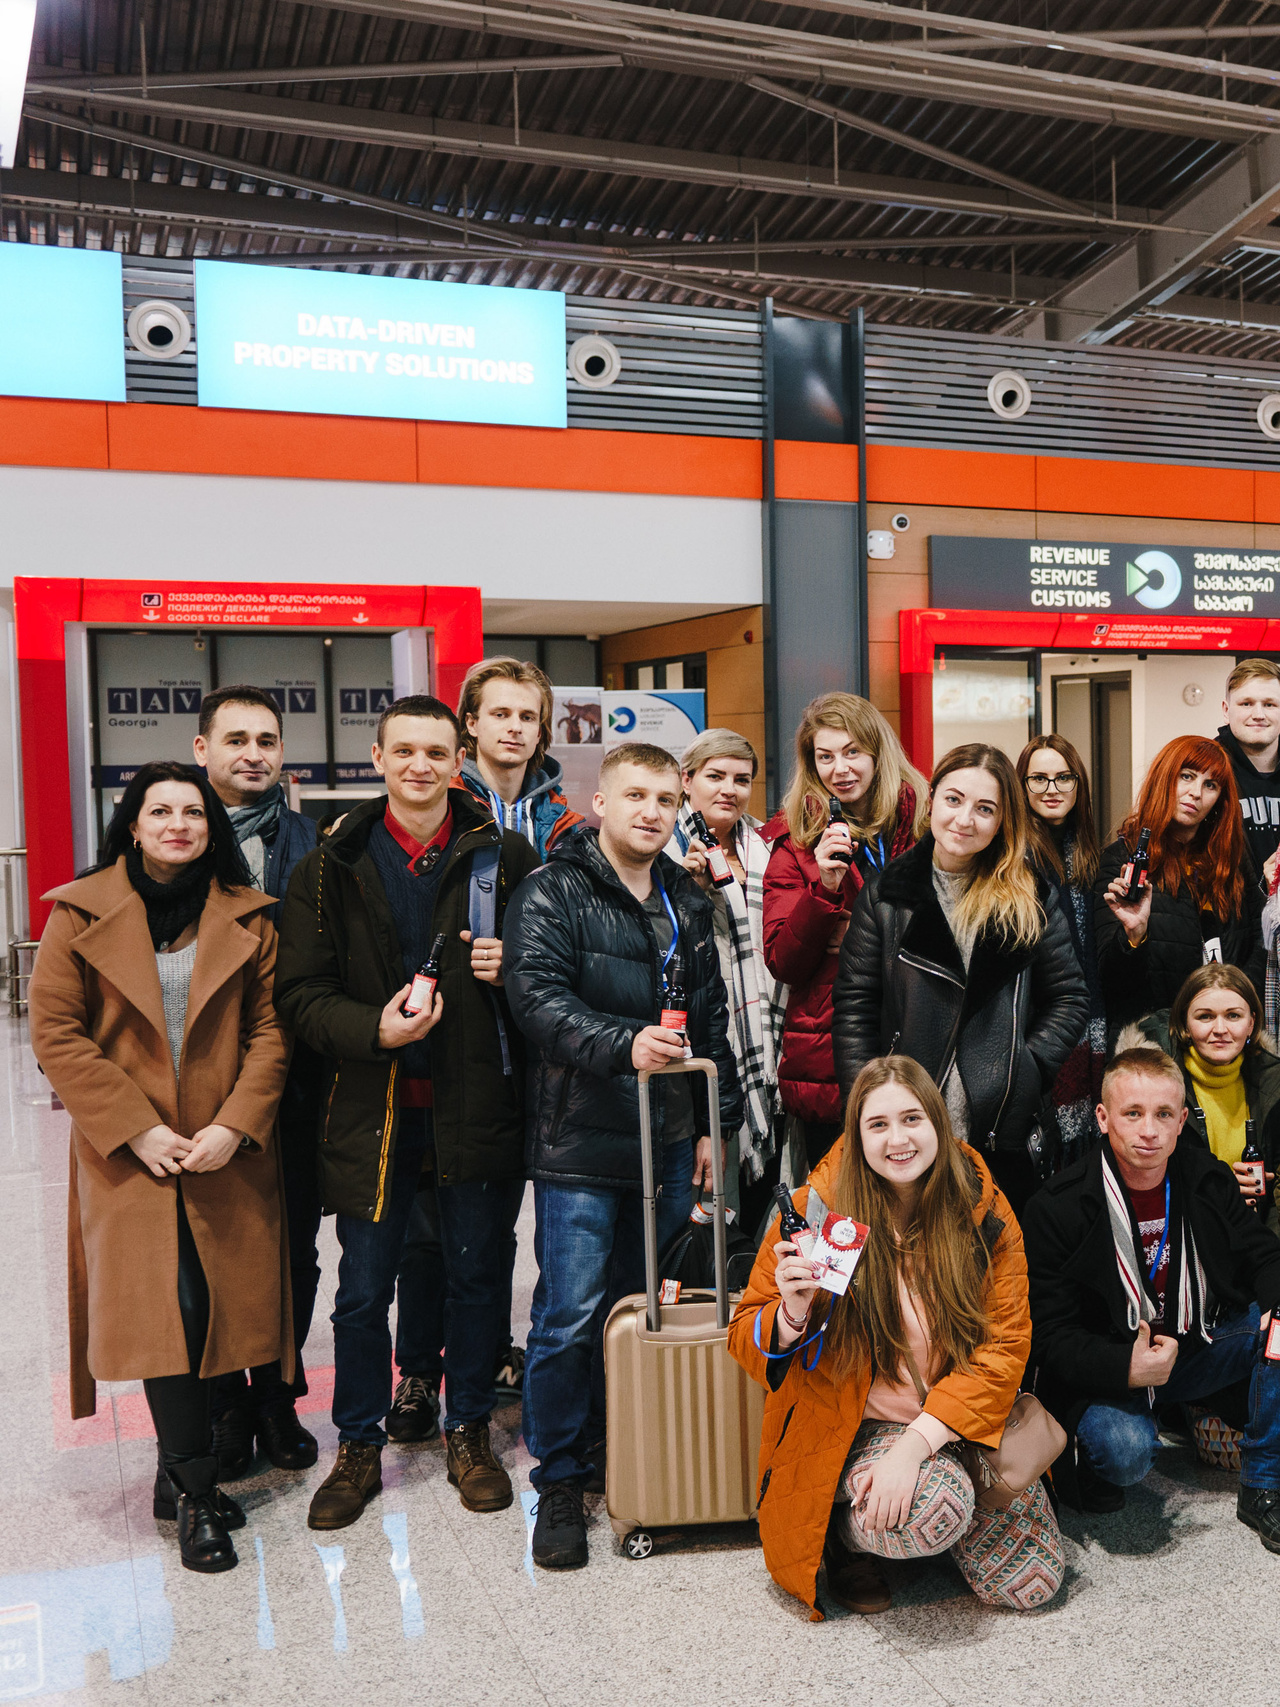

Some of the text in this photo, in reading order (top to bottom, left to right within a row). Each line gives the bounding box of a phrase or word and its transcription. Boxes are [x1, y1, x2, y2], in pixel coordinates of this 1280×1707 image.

[298, 312, 476, 349] DATA-DRIVEN
[234, 341, 535, 385] PROPERTY SOLUTIONS
[1030, 545, 1111, 566] REVENUE
[1030, 568, 1098, 587] SERVICE
[1193, 574, 1275, 593] სამსახური
[1030, 589, 1112, 608] CUSTOMS
[1193, 594, 1254, 612] საბაჟო
[167, 603, 322, 614] ПОДЛЕЖИТ ДЕКЛАРИРОВАНИЮ
[167, 613, 270, 623] GOODS TO DECLARE
[1105, 639, 1129, 647] GOODS
[111, 690, 200, 712] TAV
[108, 718, 158, 729] Georgia
